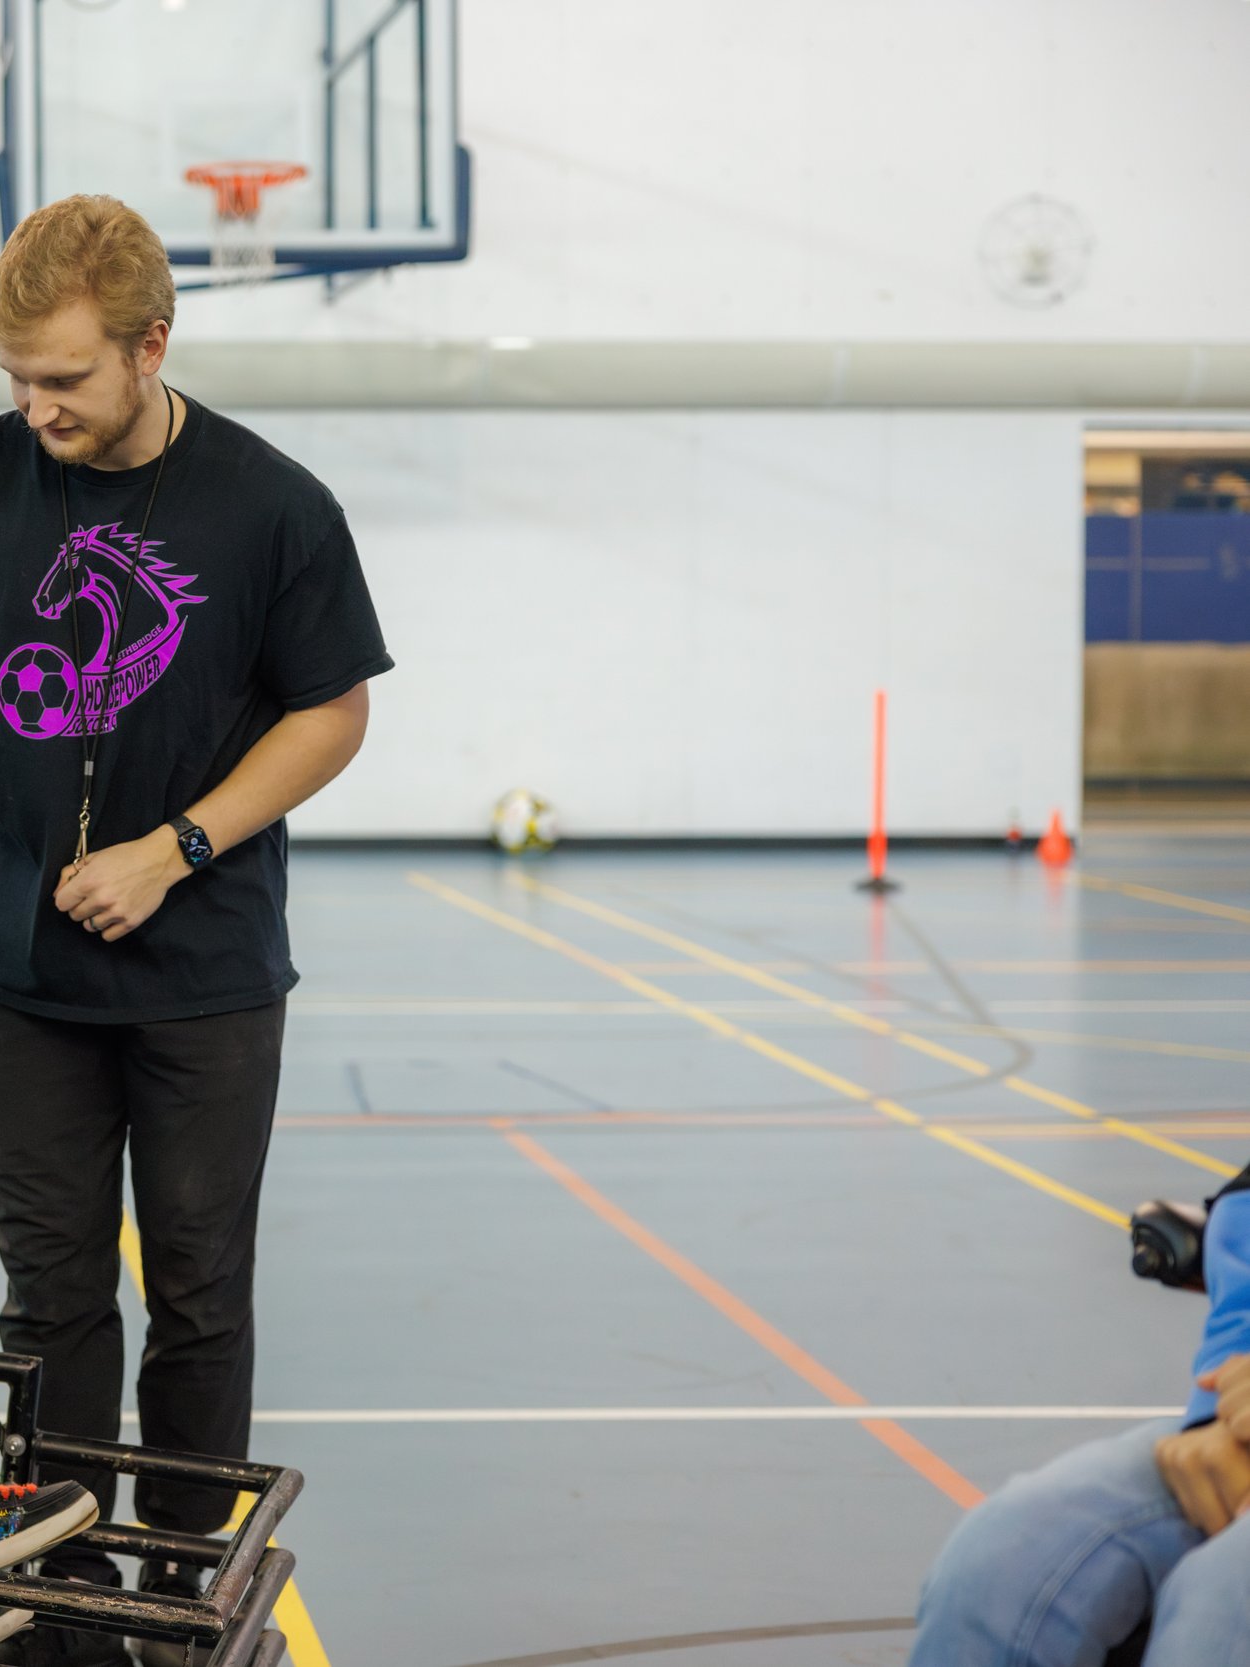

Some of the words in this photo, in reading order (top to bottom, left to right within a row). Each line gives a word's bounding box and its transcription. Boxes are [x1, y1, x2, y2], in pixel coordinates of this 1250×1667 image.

[114, 624, 163, 660] ETHBRIDGE
[84, 654, 160, 712] HOSEPOWER
[67, 715, 110, 735] SOCCR
